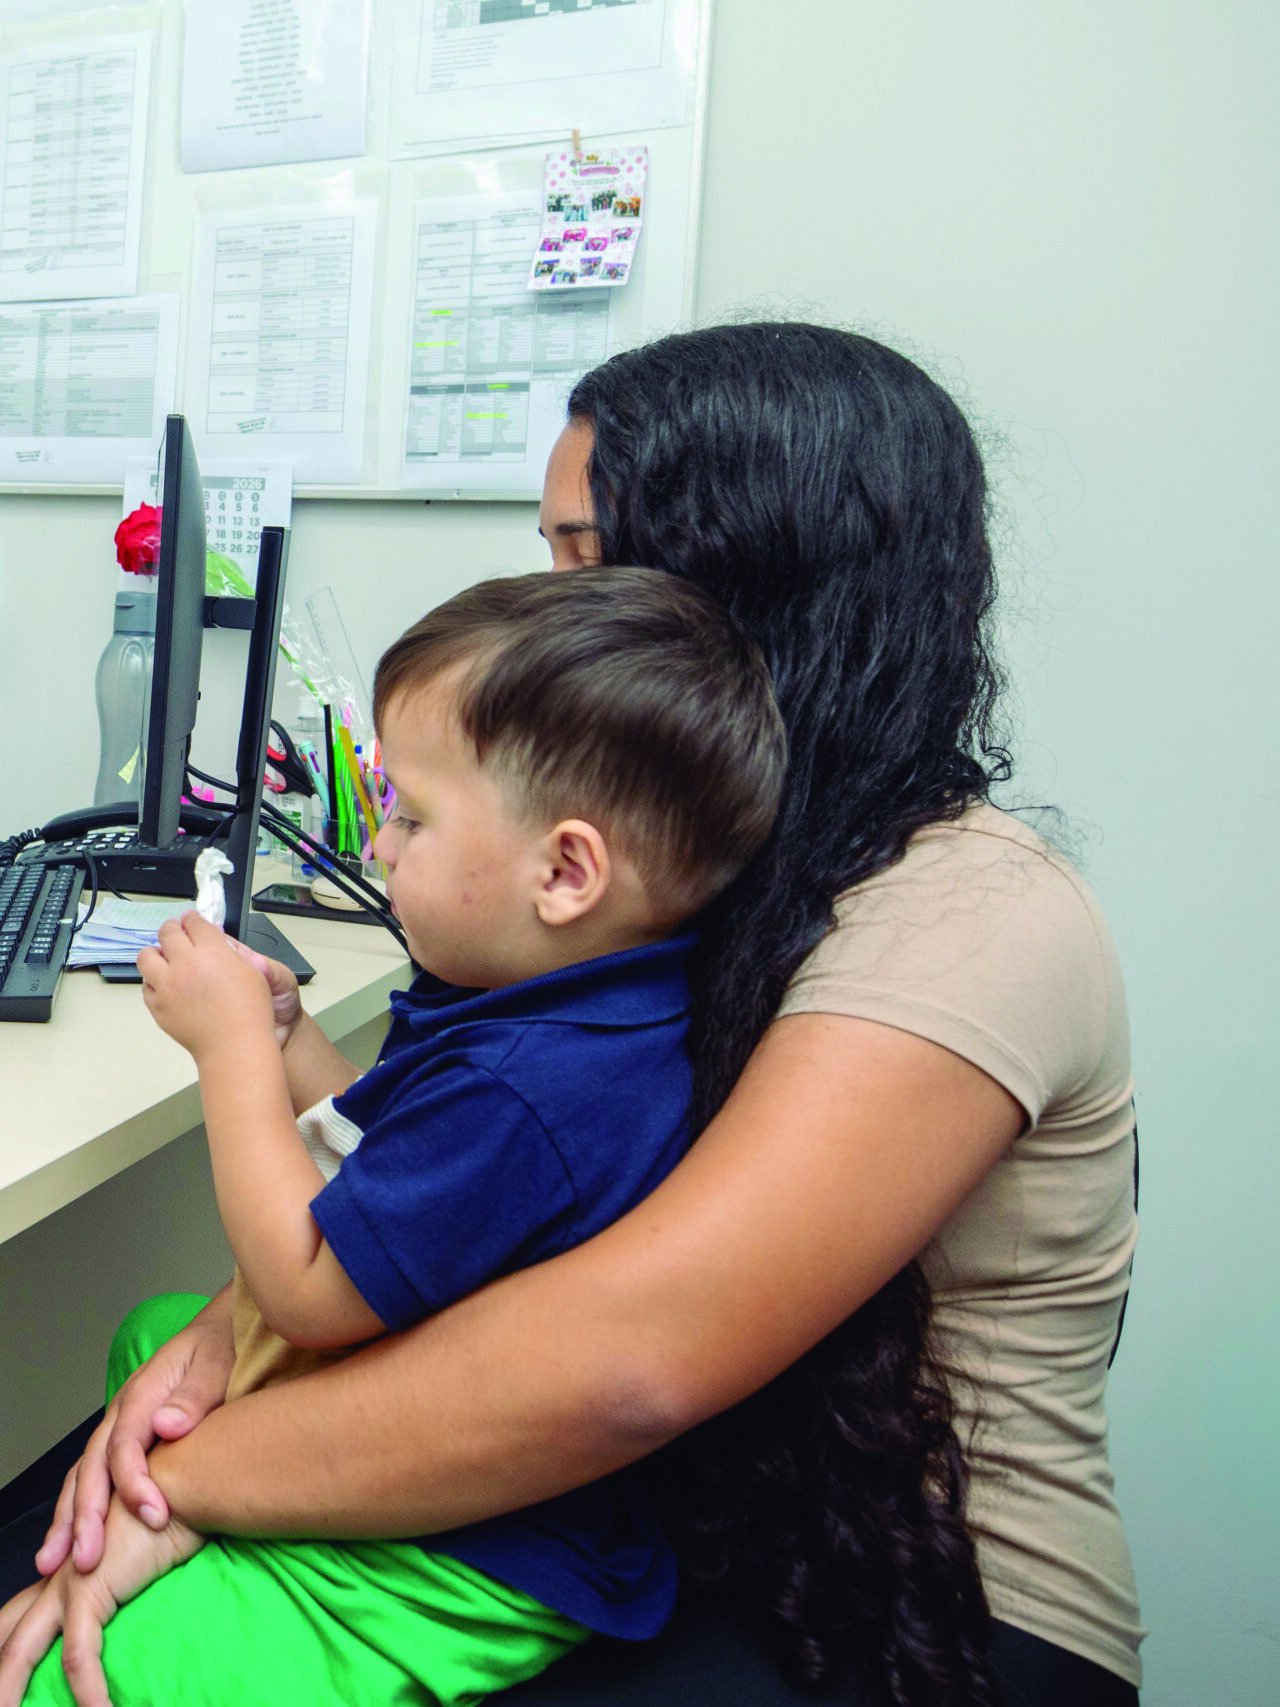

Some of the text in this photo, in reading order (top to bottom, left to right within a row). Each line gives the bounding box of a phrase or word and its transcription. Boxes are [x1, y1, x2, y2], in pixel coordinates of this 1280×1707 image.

[232, 479, 262, 489] 2026
[219, 502, 225, 511] 4
[236, 503, 242, 512] 5
[252, 503, 259, 513] 6
[218, 516, 226, 525] 11
[232, 516, 244, 526] 12
[250, 517, 260, 527] 13
[216, 529, 226, 539] 18
[232, 530, 242, 540] 19
[246, 531, 260, 541] 20
[230, 543, 243, 553] 26
[246, 544, 259, 554] 27
